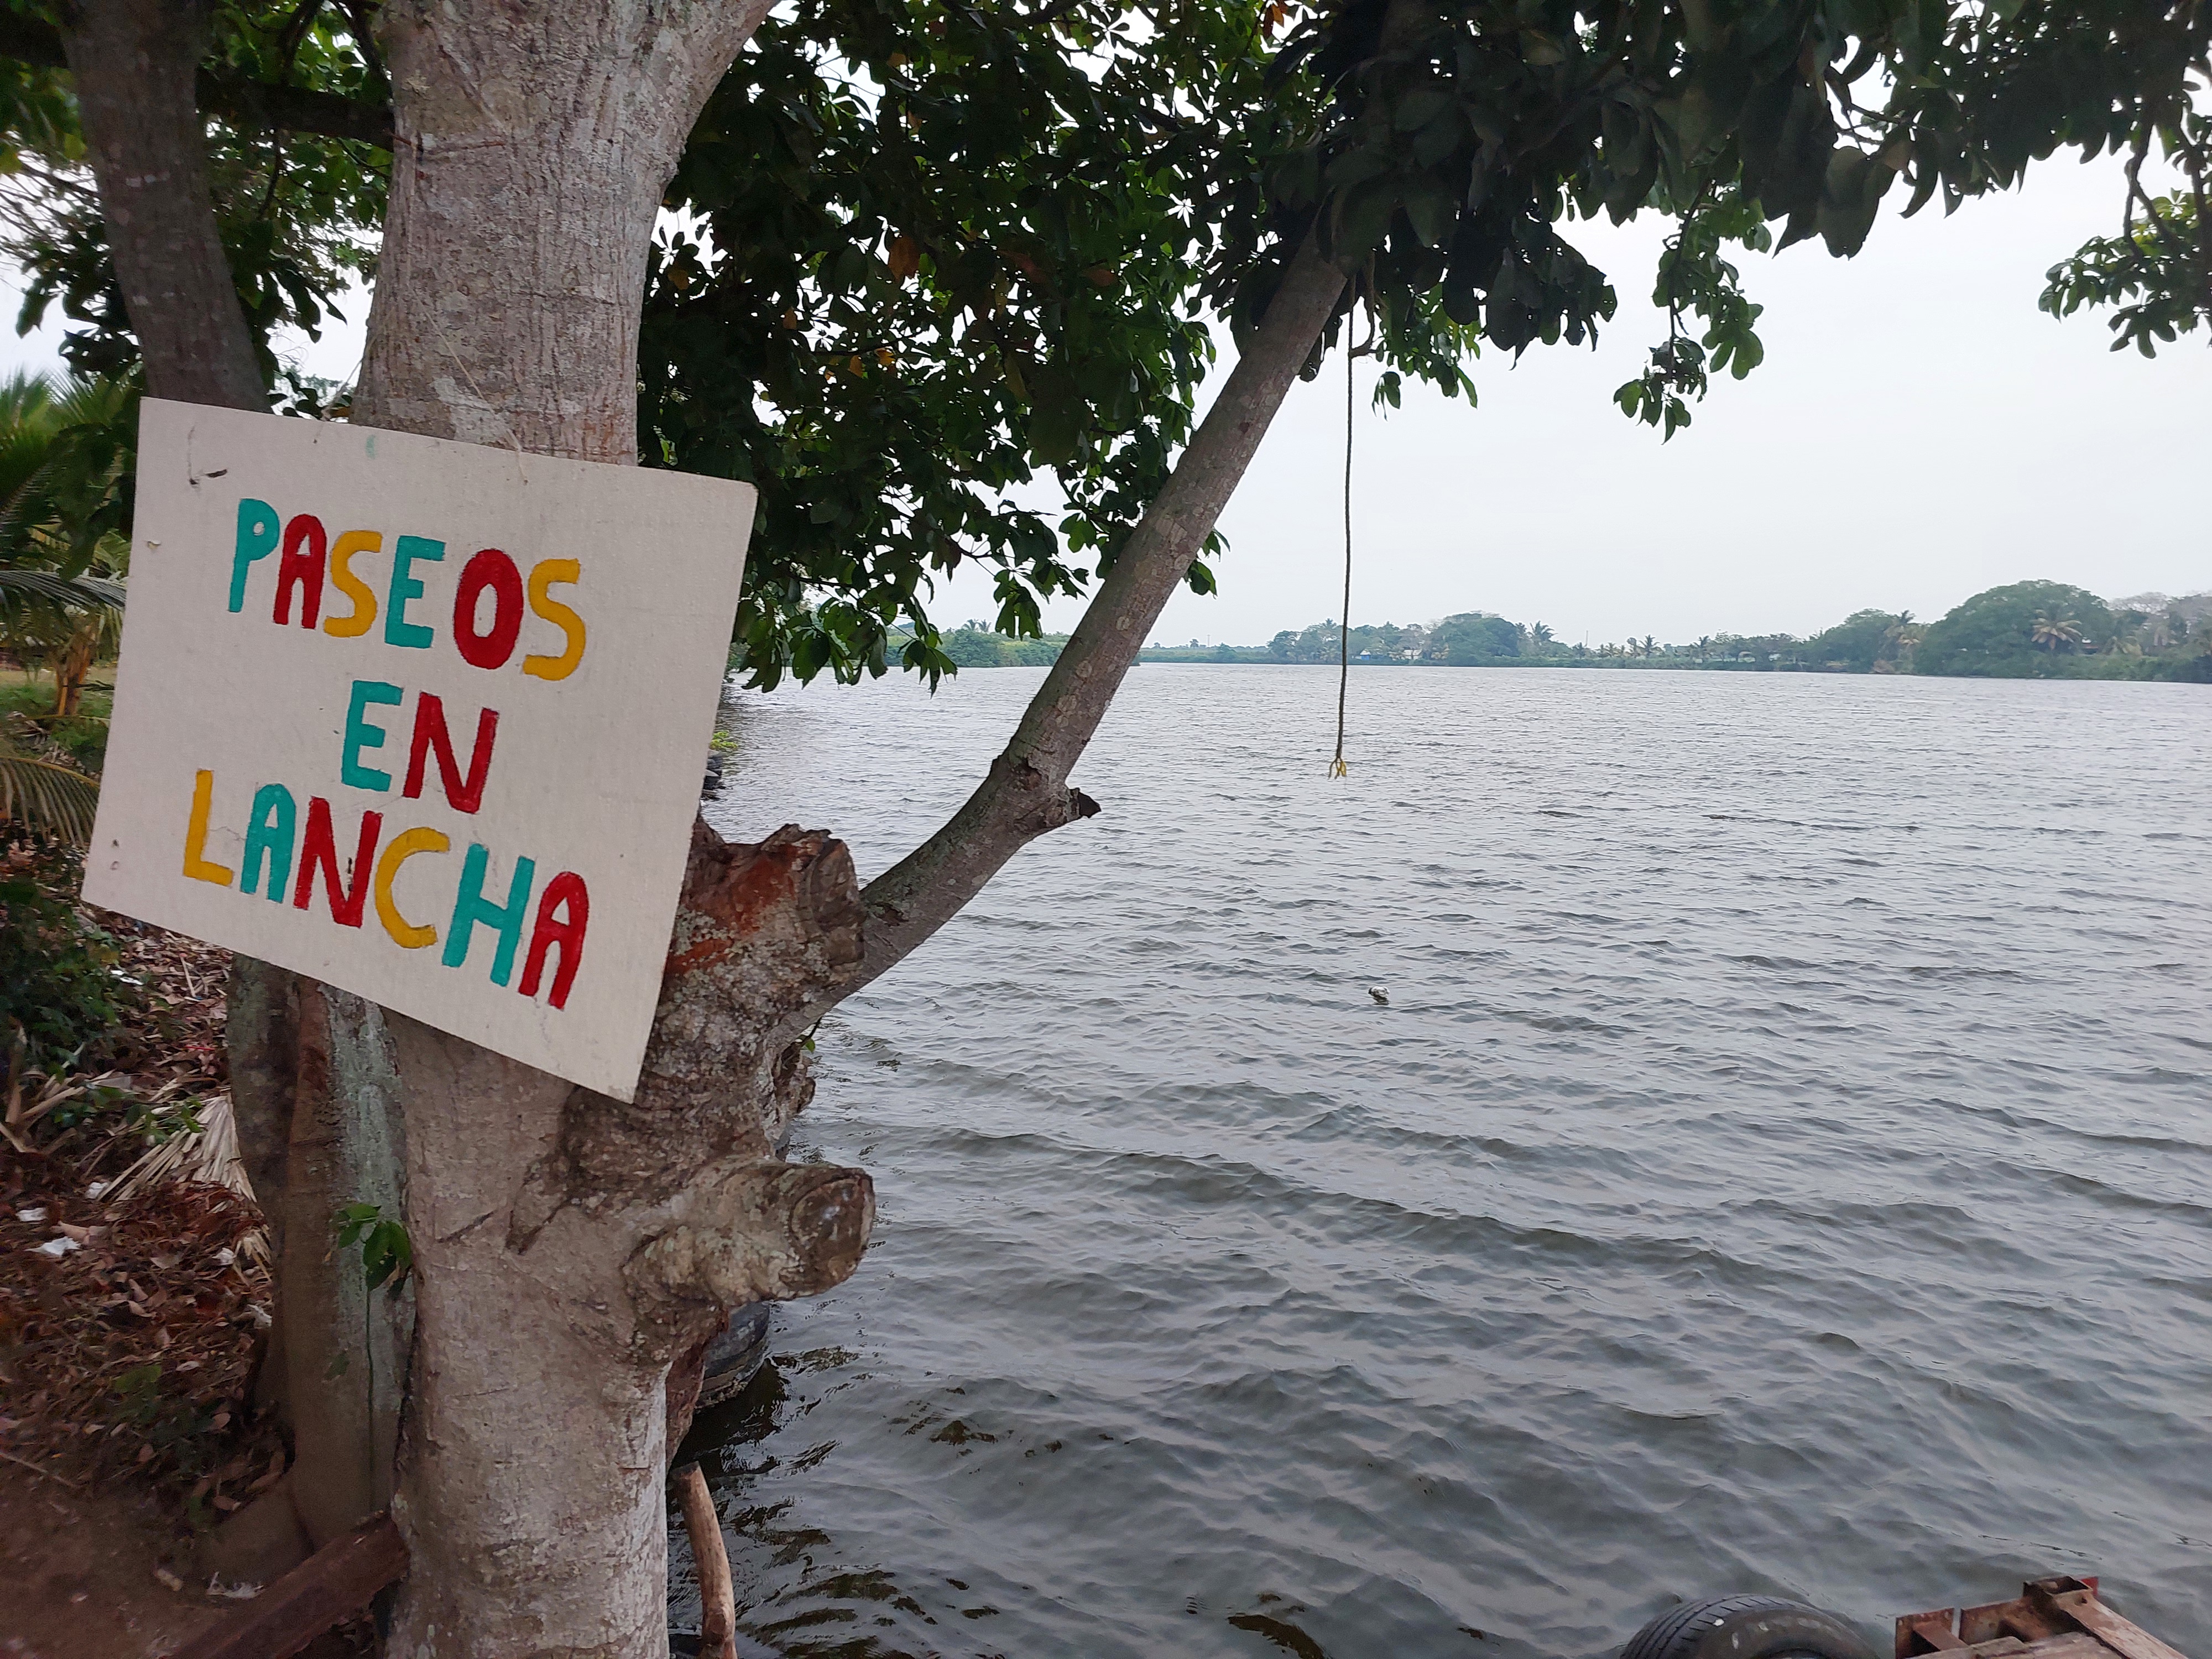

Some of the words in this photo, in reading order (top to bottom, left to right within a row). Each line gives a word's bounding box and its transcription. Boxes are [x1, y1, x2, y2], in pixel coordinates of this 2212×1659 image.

[229, 498, 586, 681] PASEOS
[341, 680, 498, 815] EN
[183, 770, 589, 1010] LANCHA
